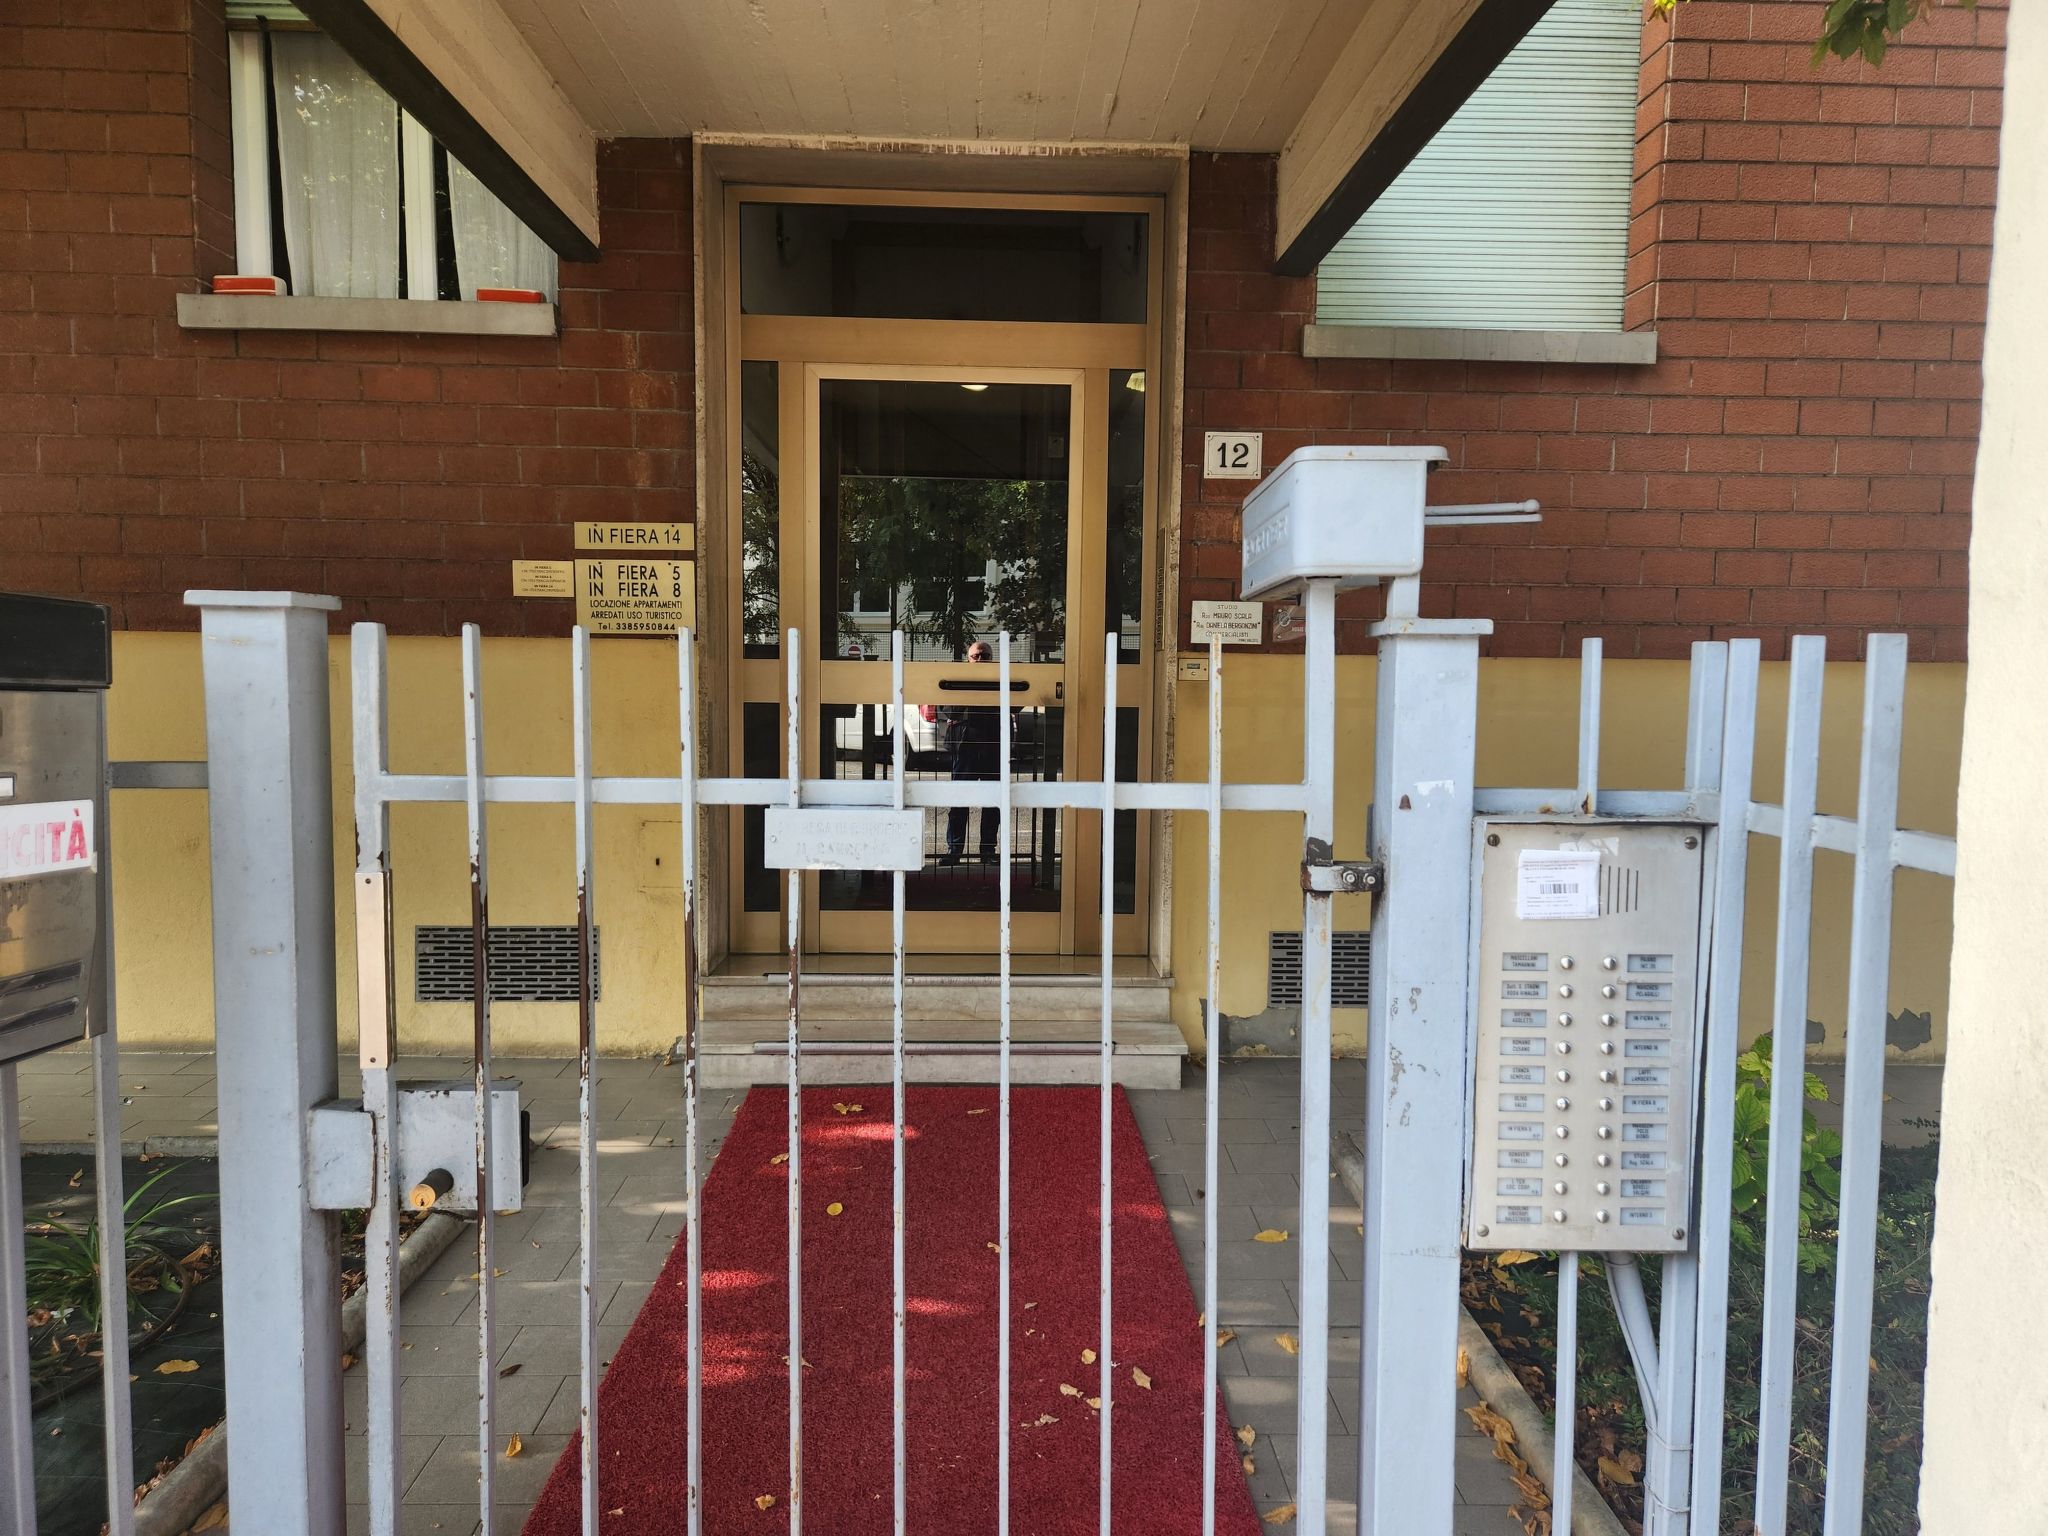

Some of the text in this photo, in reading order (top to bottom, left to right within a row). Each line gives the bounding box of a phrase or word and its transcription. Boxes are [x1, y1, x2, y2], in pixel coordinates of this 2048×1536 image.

[1217, 442, 1249, 468] 12
[588, 528, 681, 544] IN FIERA 14
[588, 564, 680, 580] IN FIERA 5
[589, 582, 681, 597] IN FIERA 8
[590, 600, 631, 608] LOCAZIONE
[590, 611, 683, 620] ARREDATI USO TURISTICO
